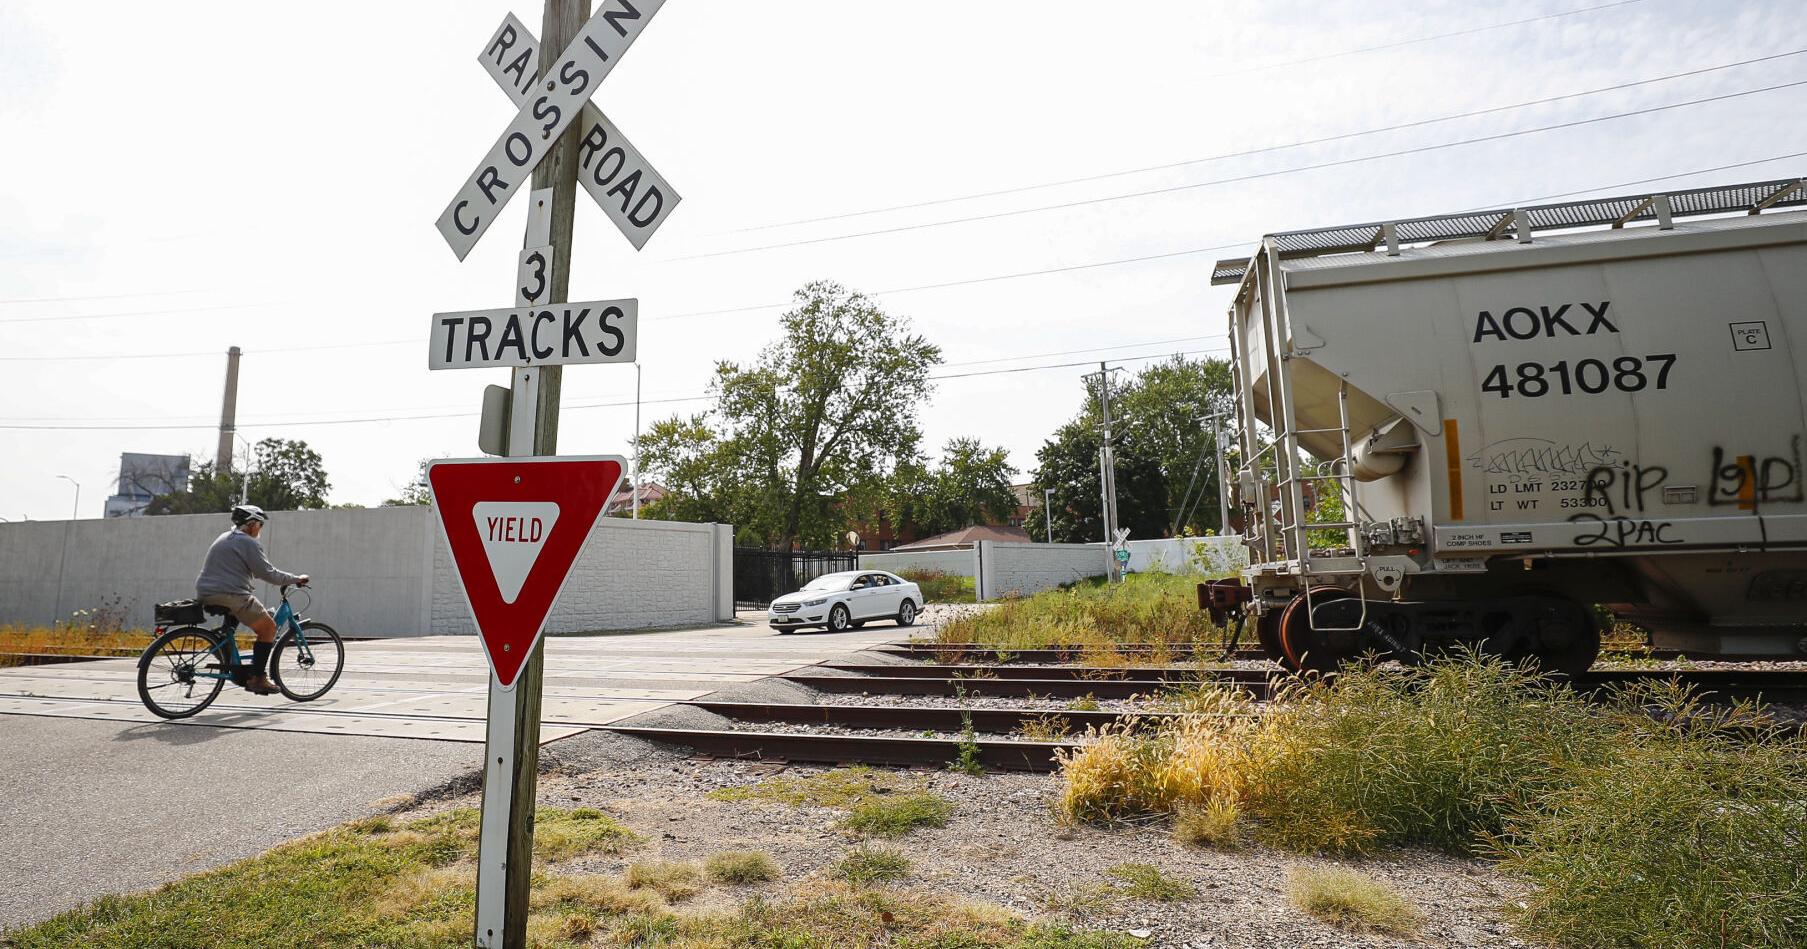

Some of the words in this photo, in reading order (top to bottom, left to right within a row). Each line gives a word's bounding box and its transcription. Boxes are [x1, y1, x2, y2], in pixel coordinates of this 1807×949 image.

[453, 0, 642, 236] CROSSIN
[488, 23, 539, 95] RAI
[579, 123, 664, 228] ROAD
[521, 254, 546, 301] 3
[441, 306, 625, 363] TRACKS
[1473, 301, 1620, 343] AOKX
[1746, 335, 1757, 344] C
[1481, 353, 1677, 399] 481087
[1490, 484, 1507, 494] LD
[1515, 482, 1543, 493] LMT
[1491, 501, 1504, 511] LT
[1517, 499, 1539, 510] WT
[487, 517, 543, 543] YIELD
[1567, 513, 1684, 547] 2PAC
